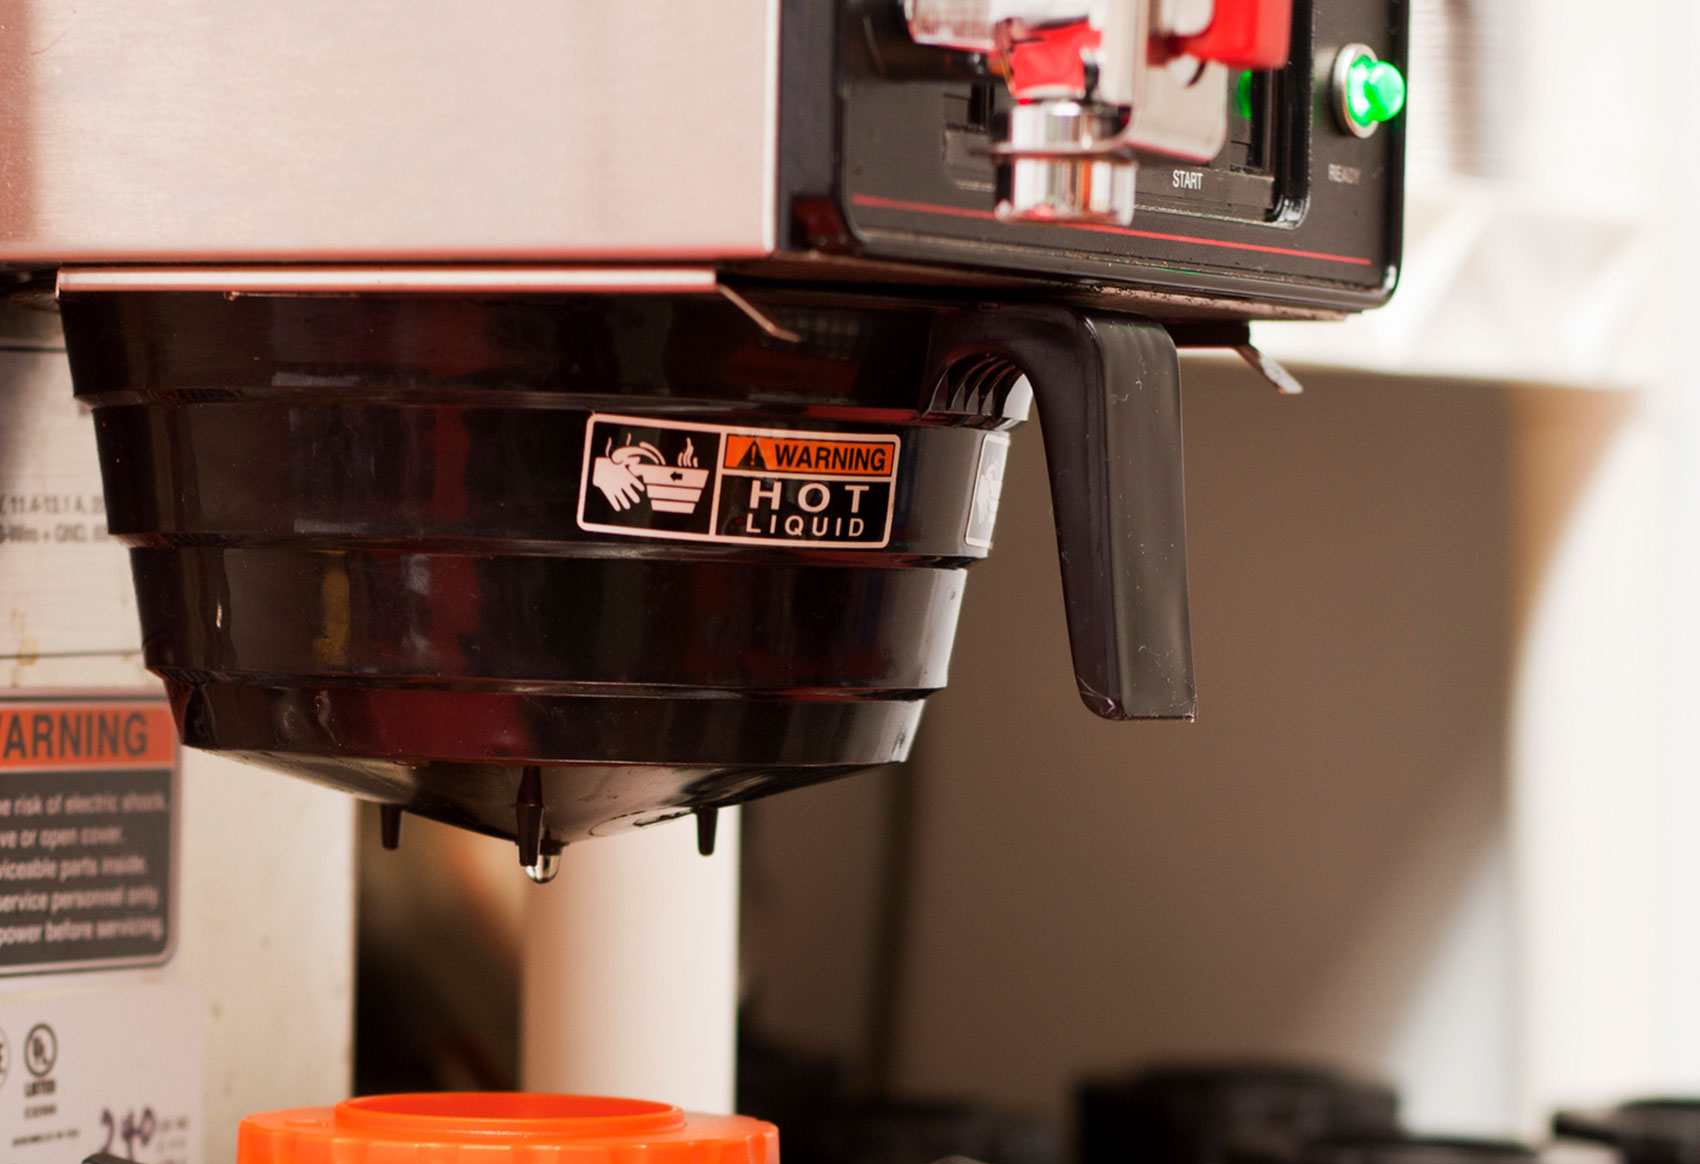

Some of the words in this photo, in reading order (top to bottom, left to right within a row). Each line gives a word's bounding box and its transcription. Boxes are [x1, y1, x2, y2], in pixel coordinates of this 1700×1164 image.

[1172, 169, 1204, 190] START
[774, 443, 887, 472] WARNING
[749, 479, 870, 514] HOT
[745, 512, 865, 538] LIQUID
[0, 712, 148, 759] ARNING
